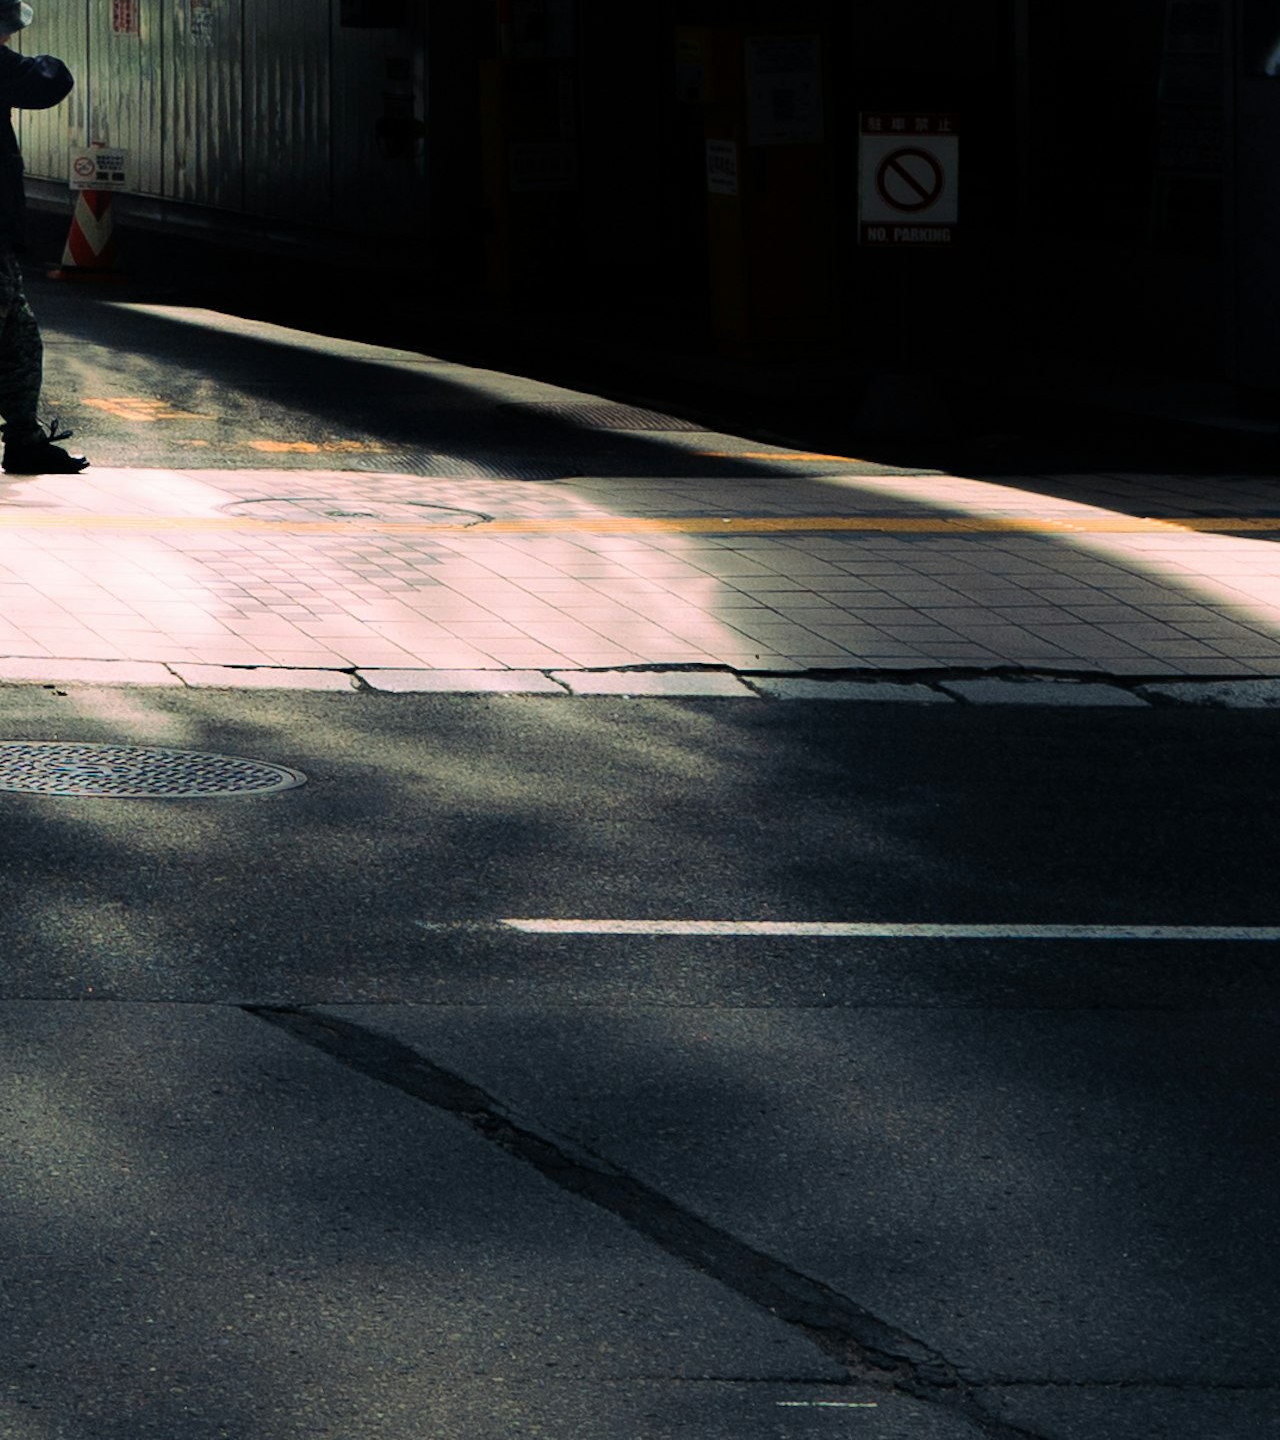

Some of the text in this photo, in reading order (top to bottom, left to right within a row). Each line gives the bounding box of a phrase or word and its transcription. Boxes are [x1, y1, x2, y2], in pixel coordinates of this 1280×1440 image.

[866, 117, 951, 132] 駐車禁止
[893, 227, 951, 242] PARKING
